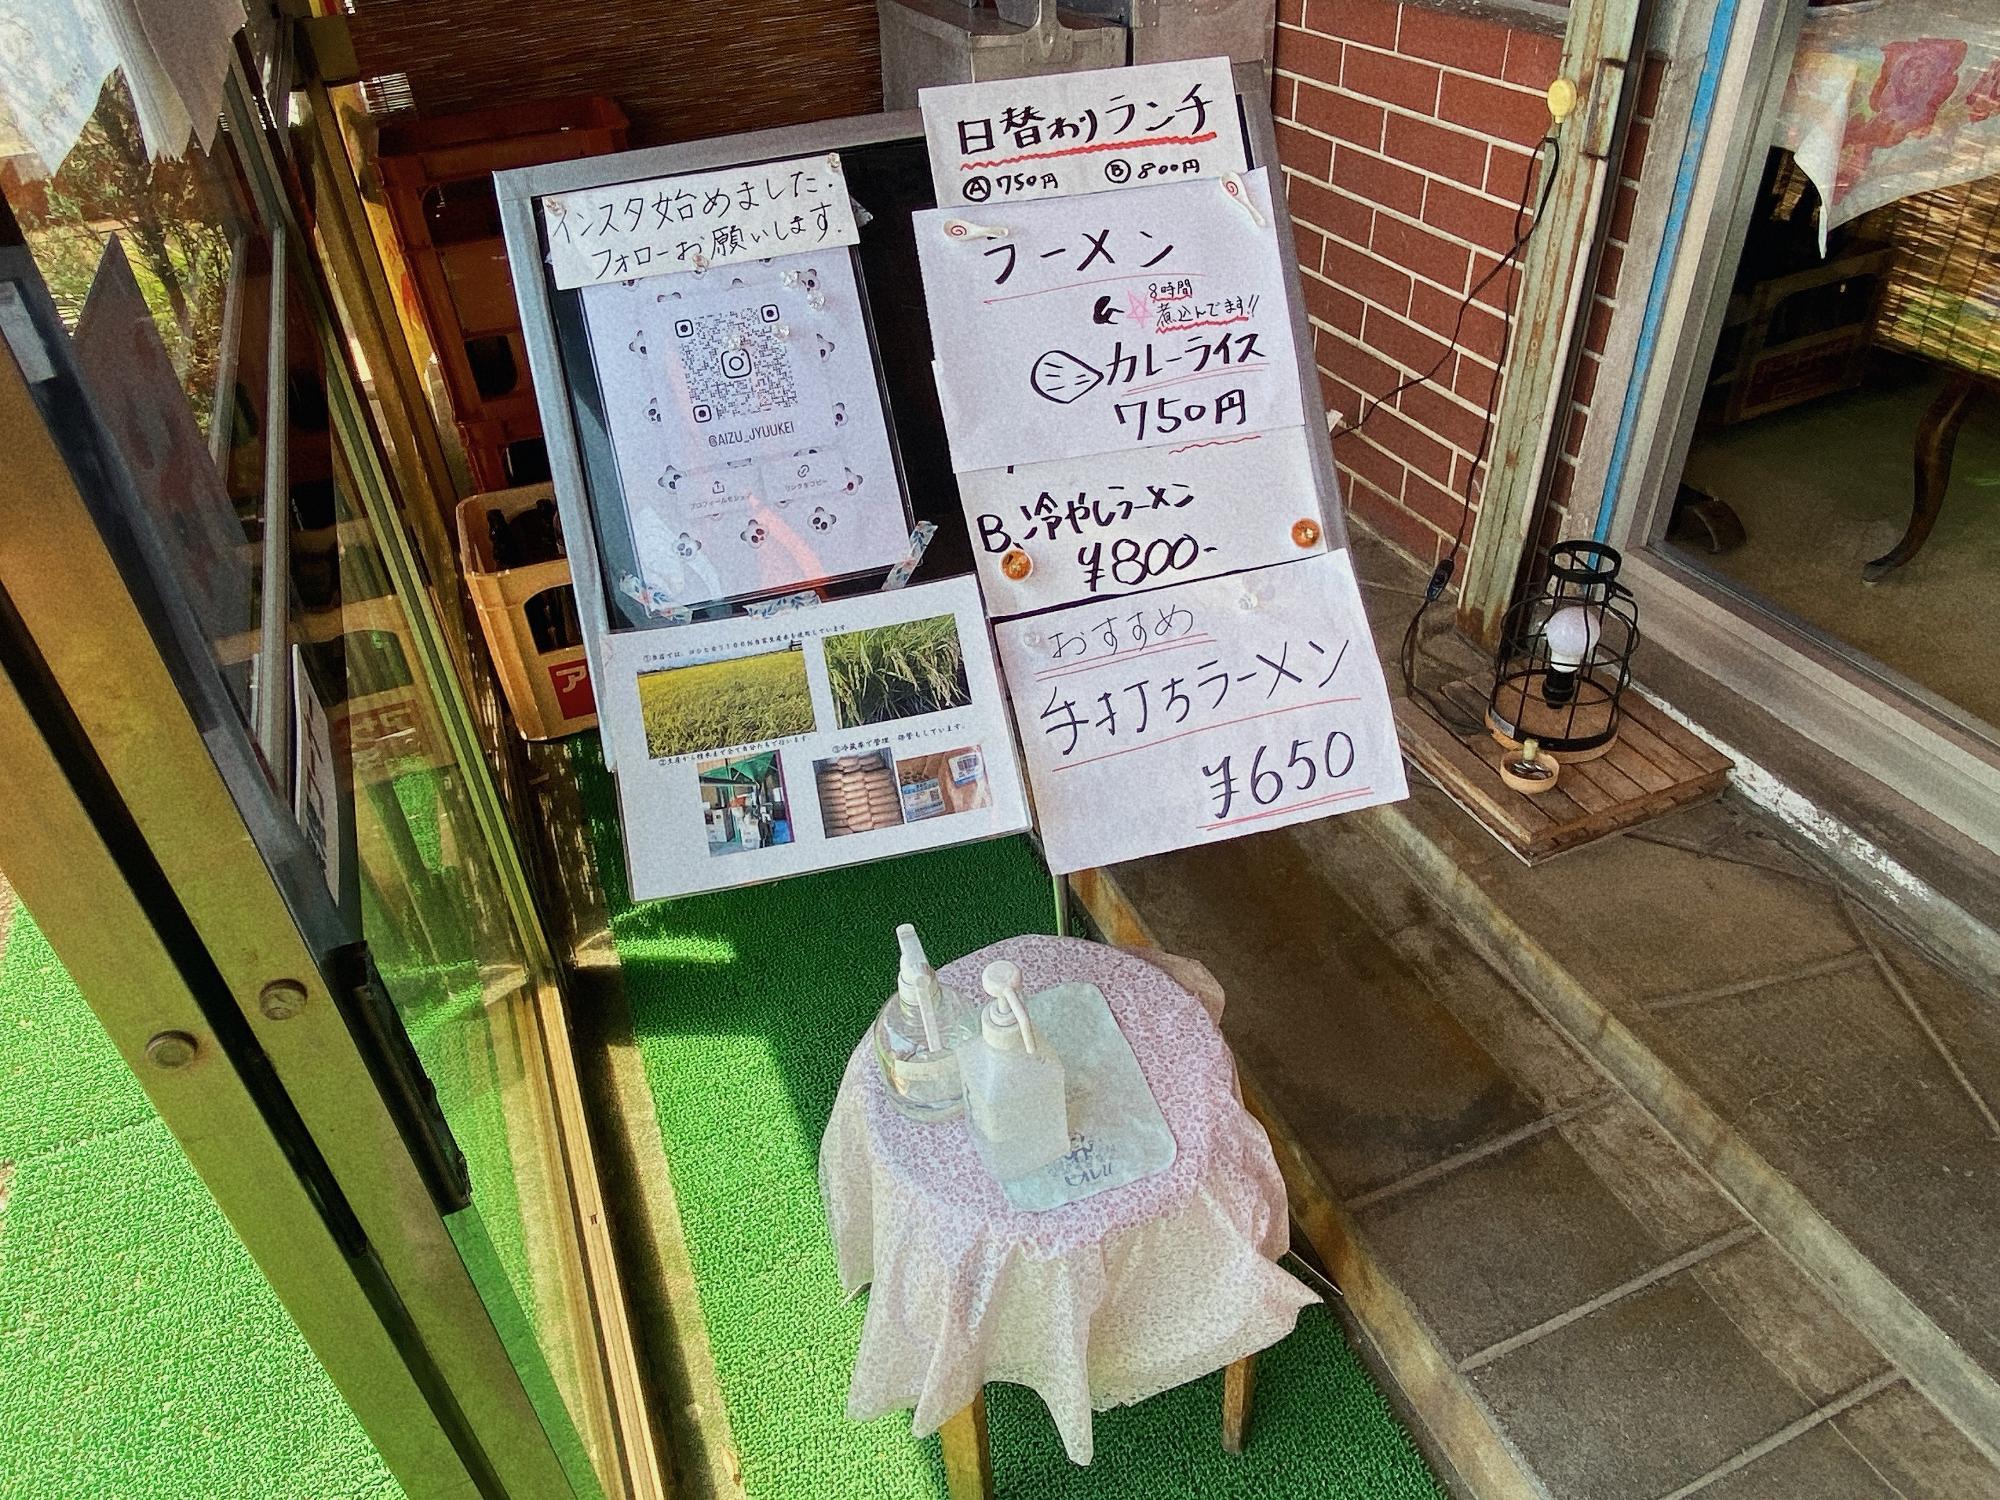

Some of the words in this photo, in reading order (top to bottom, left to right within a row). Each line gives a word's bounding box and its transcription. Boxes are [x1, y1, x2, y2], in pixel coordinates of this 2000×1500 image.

[957, 83, 1213, 155] 日替わりランチ
[984, 229, 1174, 285] ラーメン
[1148, 278, 1193, 299] 8時間
[1106, 332, 1266, 386] カレーライス
[708, 421, 796, 448] @AIZU_JYUUKEI
[1113, 388, 1247, 441] 750円
[1048, 604, 1195, 660] おすすめ
[1040, 639, 1350, 757] 手打ちラーメン
[1201, 731, 1356, 819] ¥650
